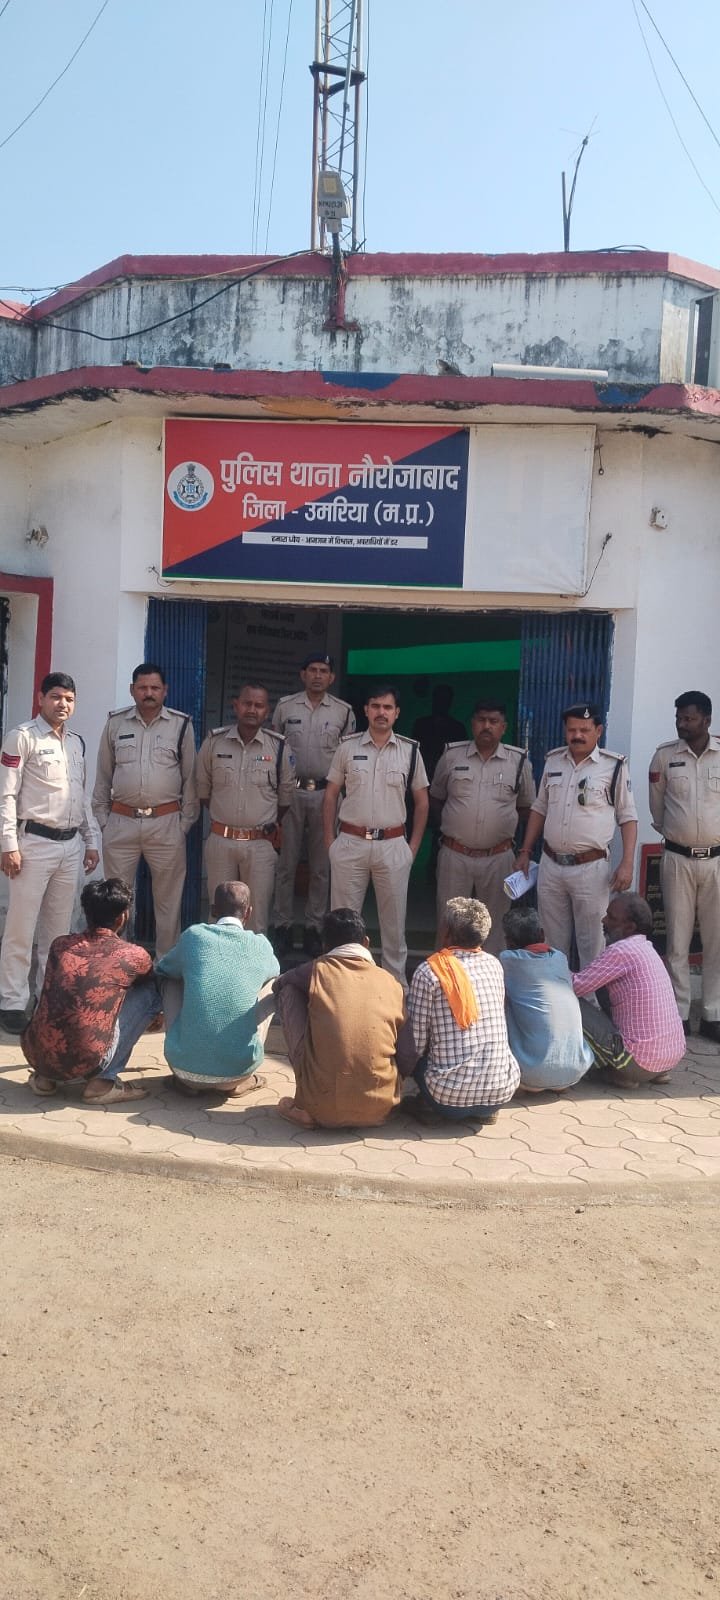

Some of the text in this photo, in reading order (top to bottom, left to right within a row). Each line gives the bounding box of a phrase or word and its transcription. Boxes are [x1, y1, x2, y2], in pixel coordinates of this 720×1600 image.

[219, 452, 460, 493] पुलिस थाना नौरोजाबाद
[242, 493, 286, 521] जिला
[304, 495, 369, 524] उमरिया
[373, 500, 435, 527] (म.प्र.)
